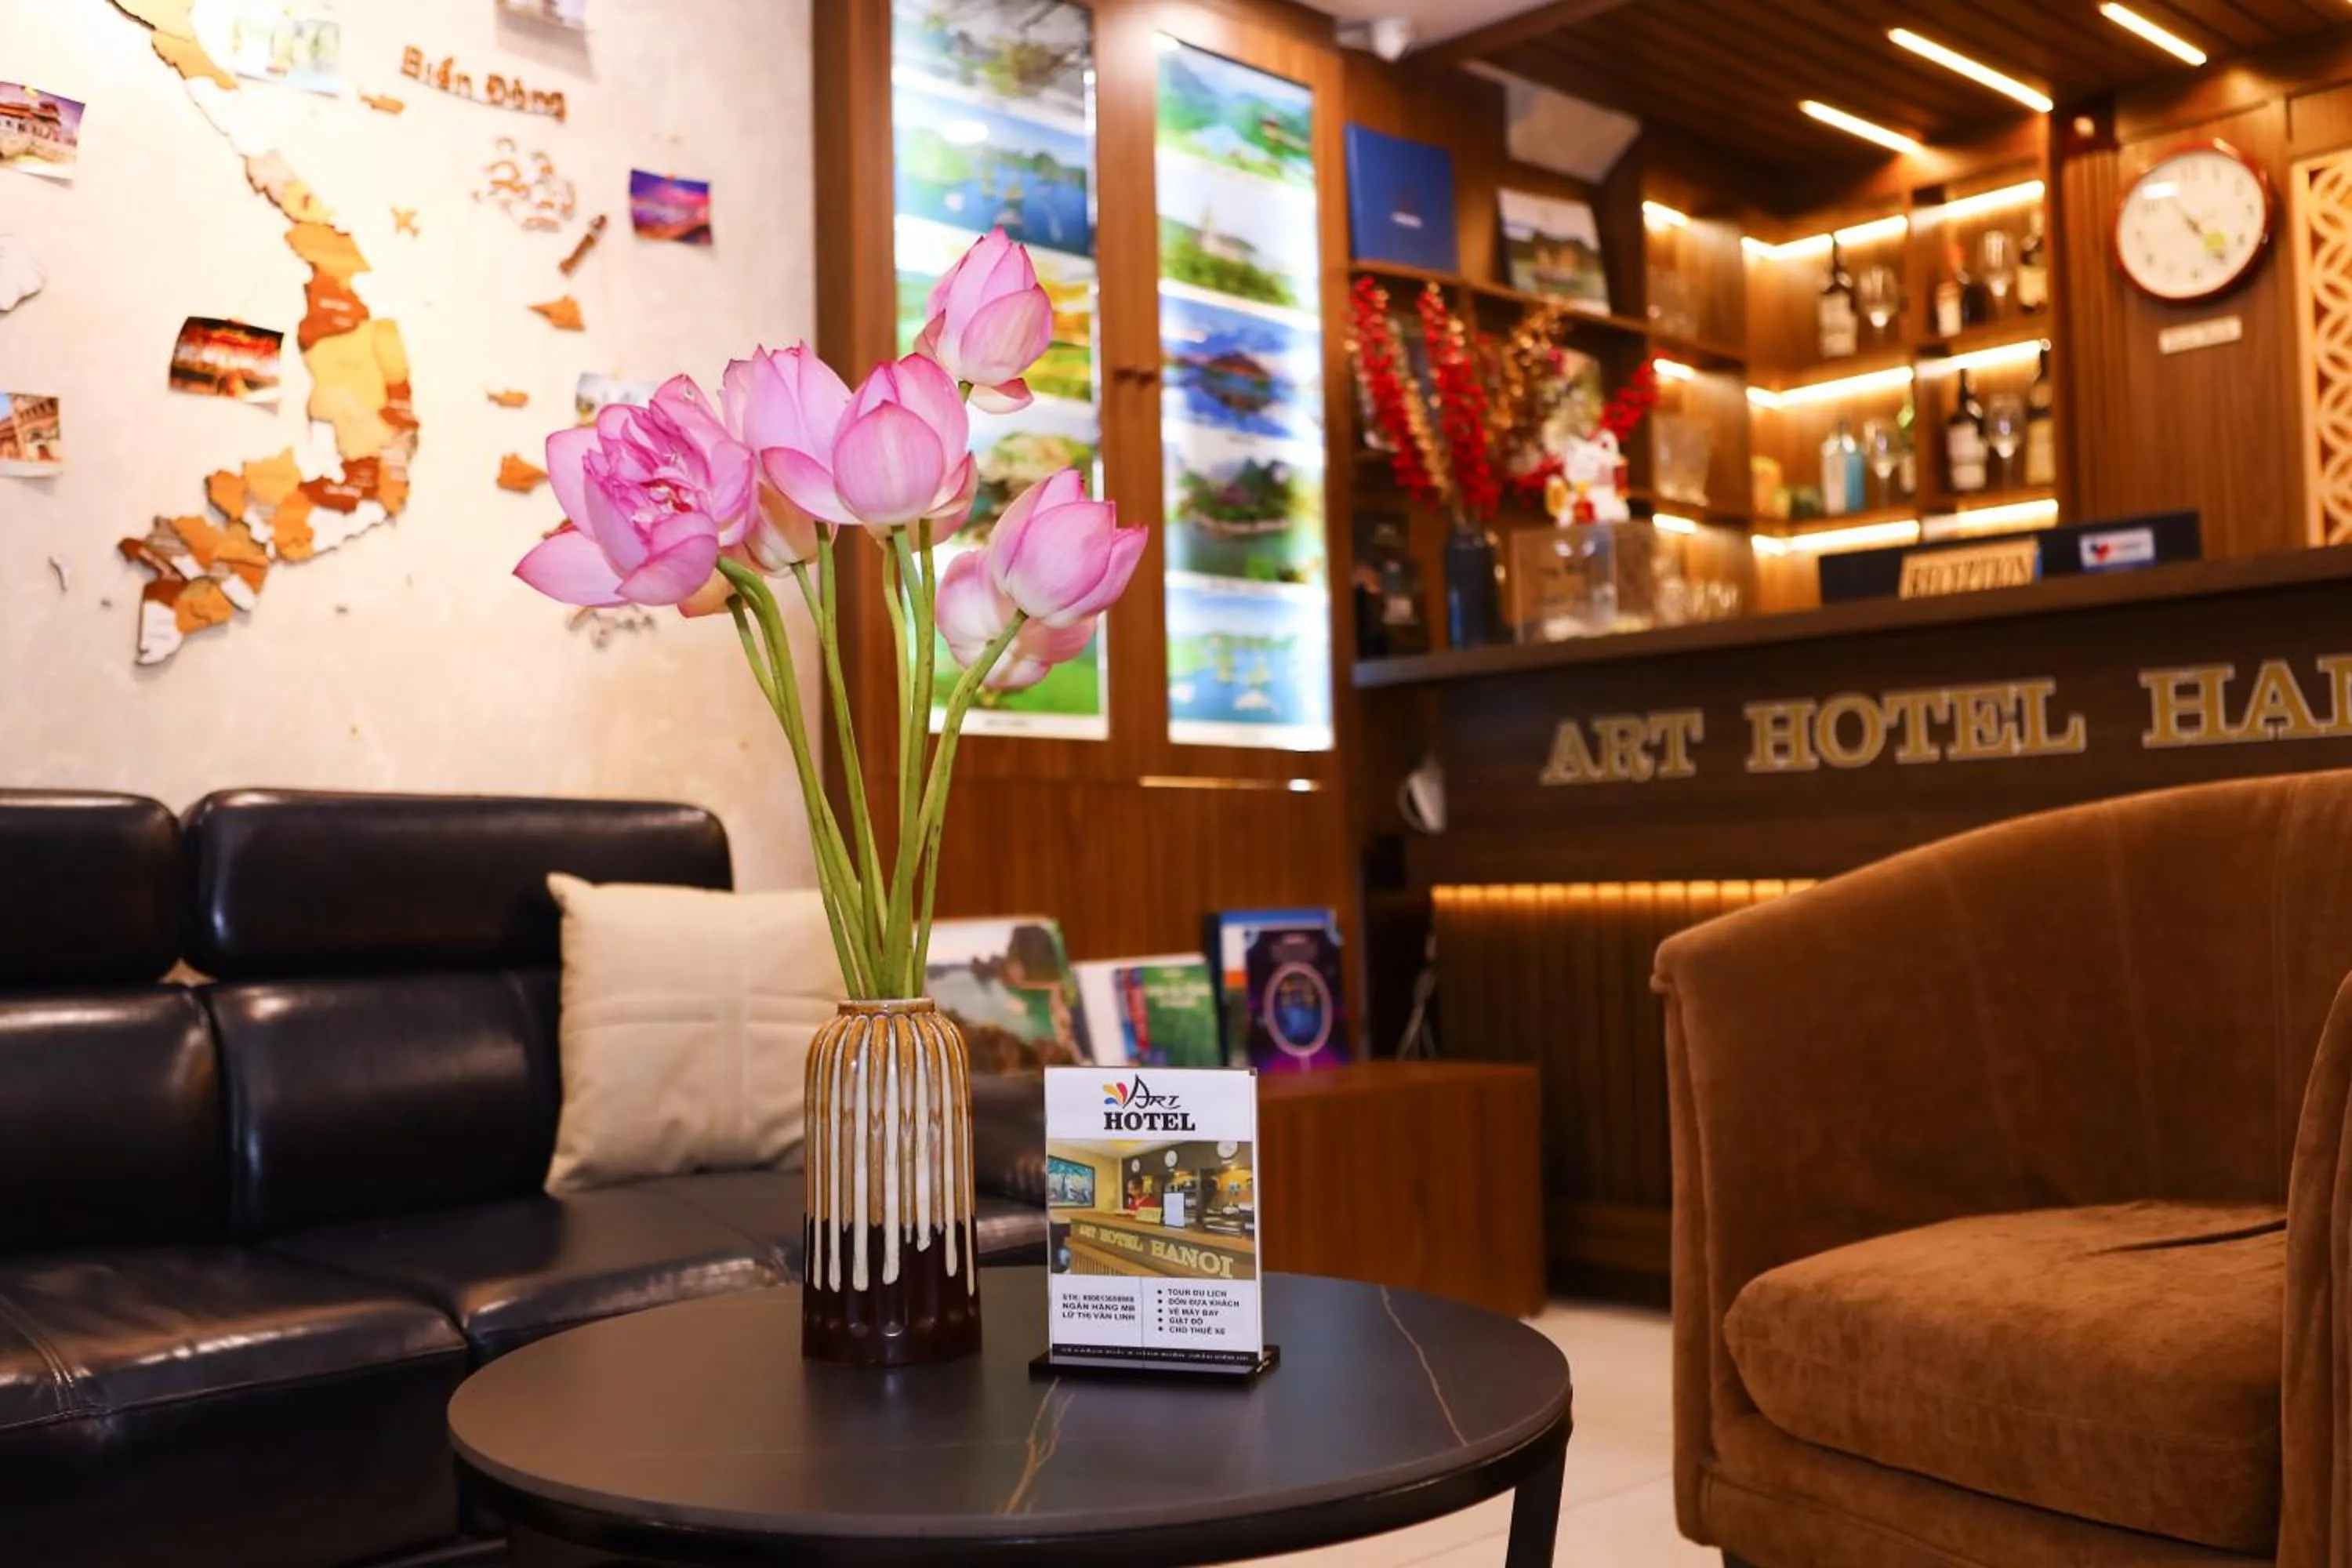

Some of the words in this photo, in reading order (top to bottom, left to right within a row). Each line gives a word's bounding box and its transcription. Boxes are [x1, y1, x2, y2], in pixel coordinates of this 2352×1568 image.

[1539, 707, 1704, 786] ART
[1742, 676, 2087, 775] HOTEL
[1104, 1111, 1196, 1131] HOTEL
[1079, 1224, 1097, 1239] ART
[1099, 1227, 1144, 1252] HOTEL
[1150, 1239, 1234, 1279] HANOI
